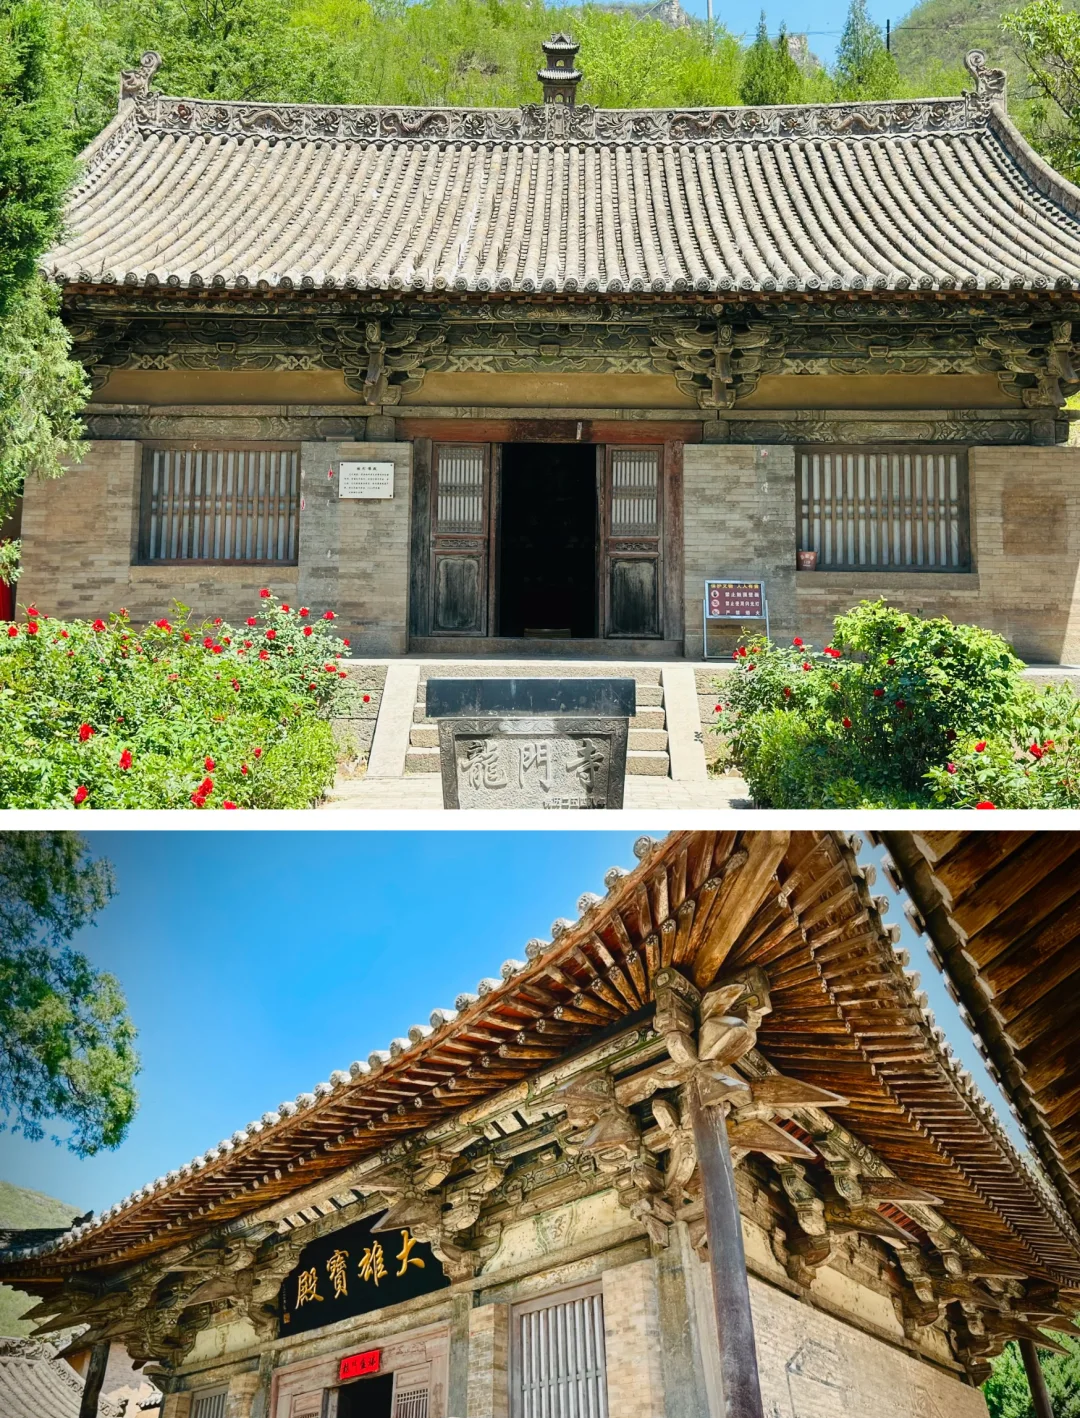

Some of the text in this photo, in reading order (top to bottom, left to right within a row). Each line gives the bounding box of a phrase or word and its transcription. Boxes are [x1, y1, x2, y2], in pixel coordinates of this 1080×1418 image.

[460, 738, 605, 793] 龍門寺
[295, 1230, 425, 1310] 大雄寶殿
